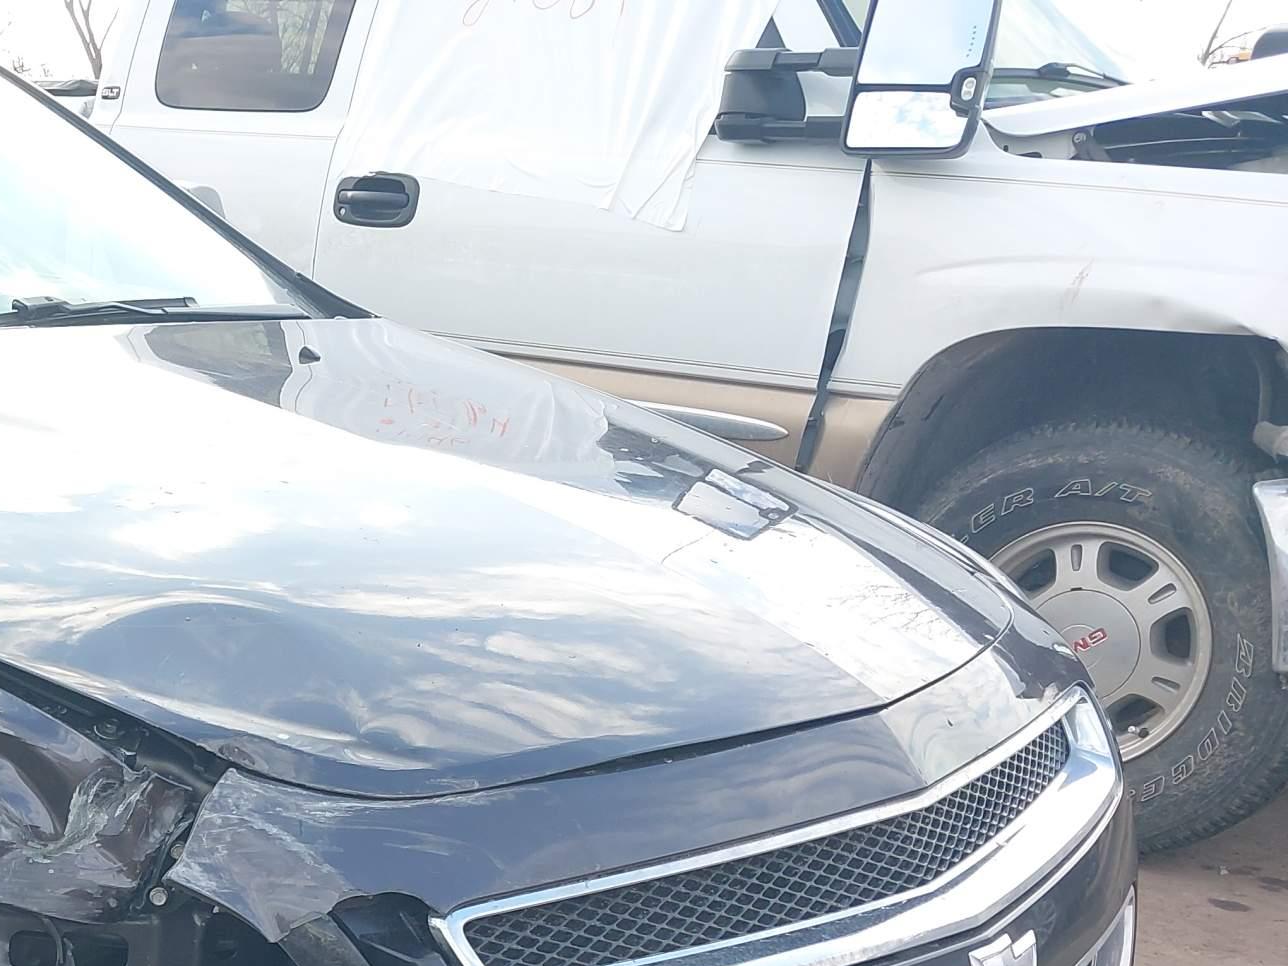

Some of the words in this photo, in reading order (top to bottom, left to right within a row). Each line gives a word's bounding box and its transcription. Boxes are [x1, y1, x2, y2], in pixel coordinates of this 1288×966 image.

[1054, 478, 1153, 503] A/T
[1072, 627, 1109, 653] GM
[1127, 633, 1255, 802] BRIDGE
